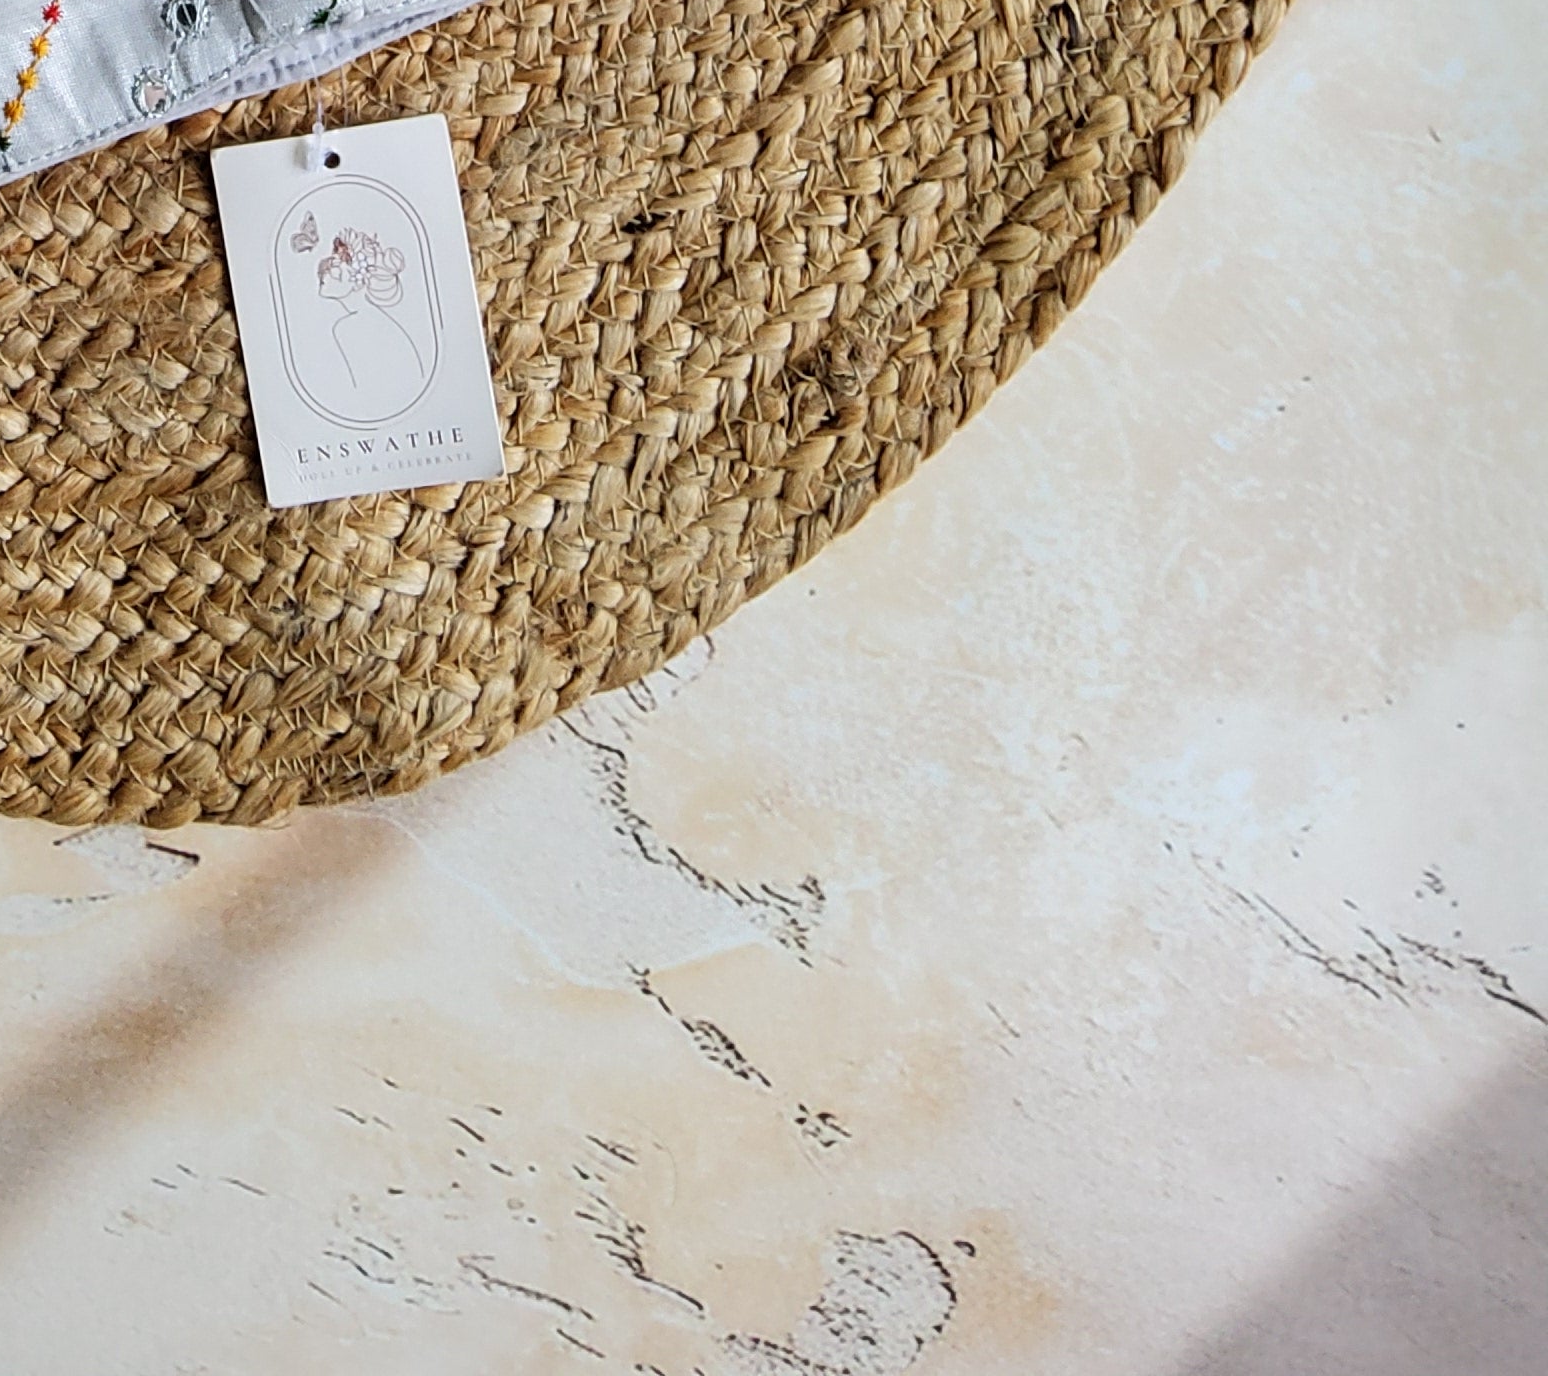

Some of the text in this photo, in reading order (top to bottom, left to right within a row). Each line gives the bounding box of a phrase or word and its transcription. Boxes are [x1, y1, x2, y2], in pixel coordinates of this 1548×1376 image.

[297, 427, 464, 464] ENSWATHE
[370, 462, 379, 473] &
[387, 452, 472, 470] CELEBRATE
